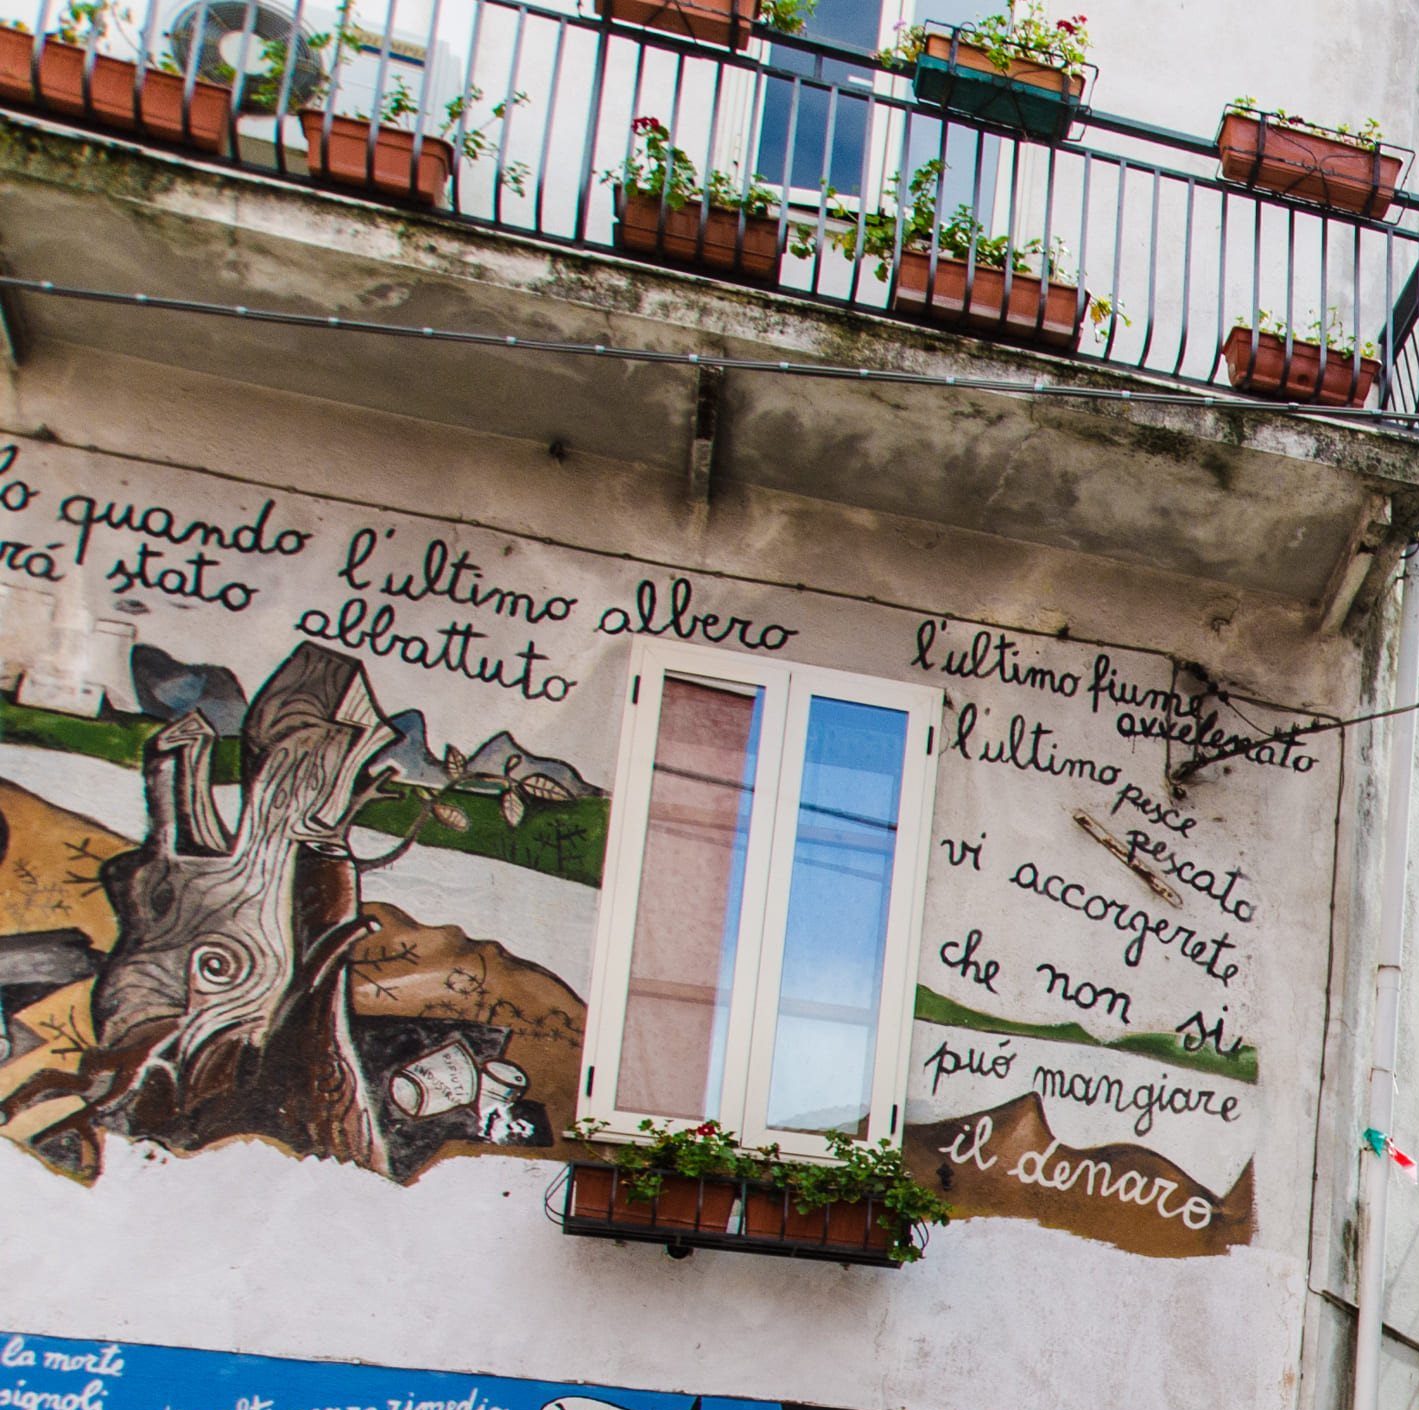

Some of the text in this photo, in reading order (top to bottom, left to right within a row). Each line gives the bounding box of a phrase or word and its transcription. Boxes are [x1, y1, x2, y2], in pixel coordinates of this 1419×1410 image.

[57, 494, 312, 566] quando
[339, 525, 580, 623] l'ultimo
[596, 577, 801, 653] albero
[105, 541, 260, 612] stato
[294, 598, 579, 704] abbattuto
[910, 618, 1201, 719] l'ultimo fiume
[948, 705, 1198, 840] l'ultimo pesce
[1115, 709, 1320, 774] avvelenato
[940, 832, 1242, 987] vi accorgerete
[1126, 829, 1254, 923] pescato
[938, 927, 1244, 1055] che non si
[1031, 1058, 1243, 1137] mangiare
[938, 1115, 1215, 1231] il denaro
[43, 1344, 125, 1377] morte
